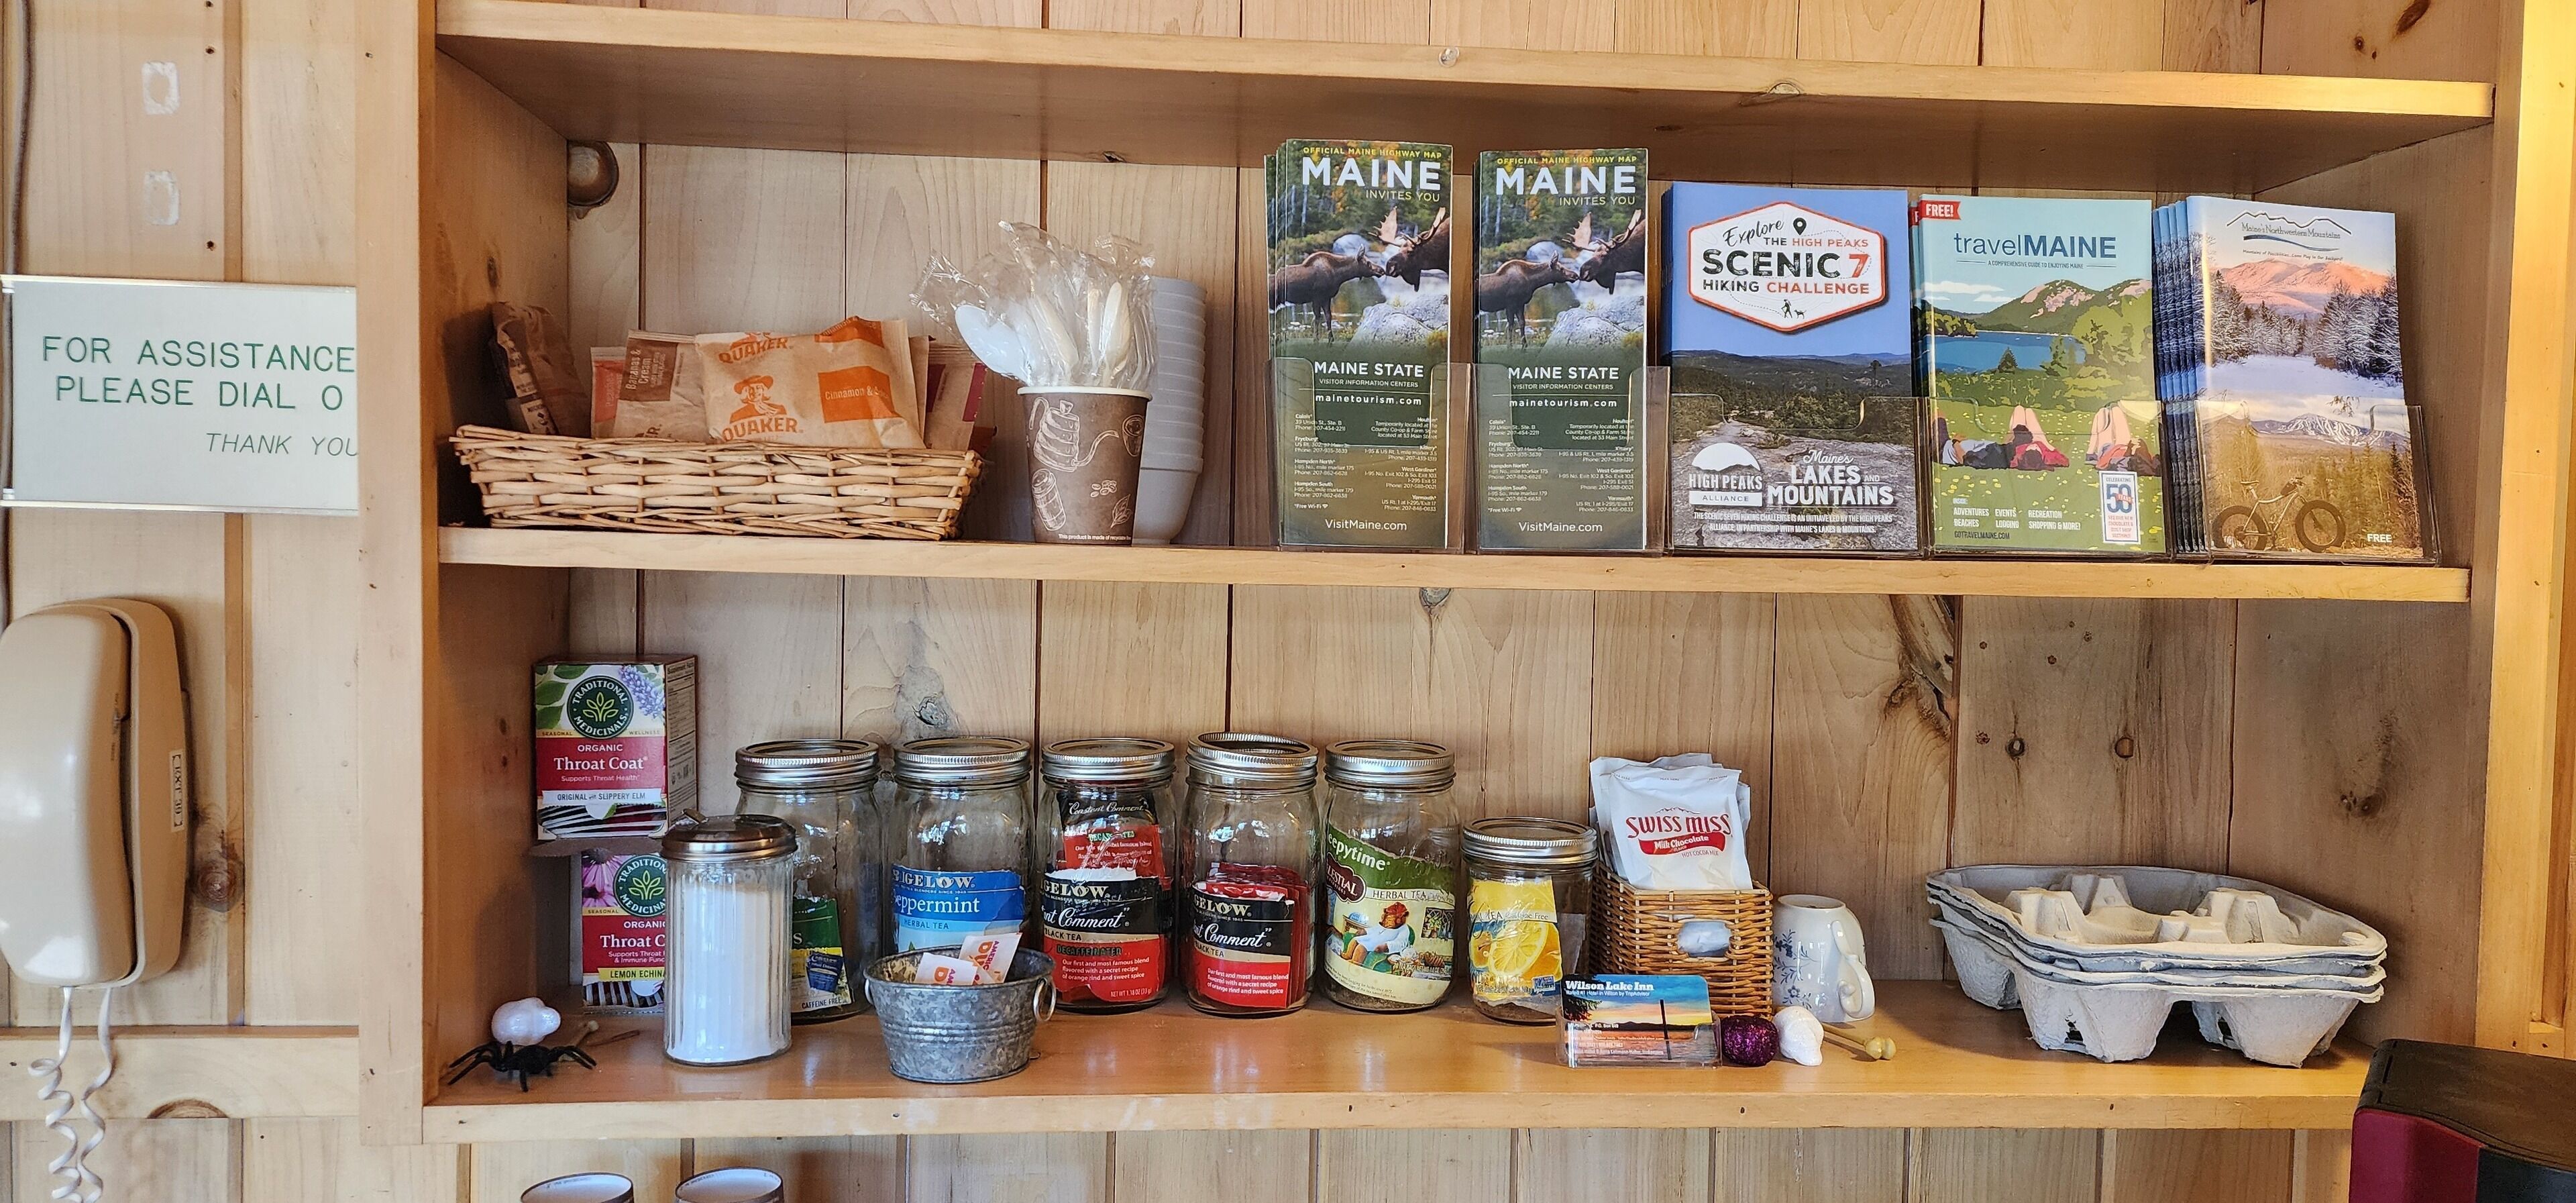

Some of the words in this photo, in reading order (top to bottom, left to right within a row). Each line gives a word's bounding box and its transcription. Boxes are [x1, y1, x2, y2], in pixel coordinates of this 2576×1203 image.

[1303, 146, 1344, 155] OFFICIAL
[1348, 148, 1376, 156] MAINE
[1380, 149, 1420, 158] HIGHWAY
[1424, 151, 1442, 159] MAP
[1302, 157, 1441, 191] MAINE
[1496, 166, 1635, 195] MAINE
[1366, 190, 1411, 201] INVITES
[1416, 192, 1440, 202] YOU
[1560, 197, 1606, 205] INVITES
[1611, 196, 1635, 205] YOU
[1925, 203, 1953, 217] FREE!
[1723, 219, 1784, 247] Explore
[2242, 222, 2265, 233] Maine's
[2265, 225, 2307, 236] Northwestern
[2308, 228, 2341, 239] Mountains
[1764, 237, 1787, 246] THE
[1792, 238, 1822, 247] HIGH
[1828, 239, 1868, 248] PEAKS
[1953, 232, 2116, 258] travelMAINE
[1703, 248, 1840, 278] SCENIC
[1849, 254, 1868, 278] 7
[1703, 279, 1759, 293] HIKING
[1767, 282, 1869, 295] CHALLENGE
[42, 336, 111, 363] FOR
[138, 339, 355, 372] ASSISTANCE
[718, 337, 788, 364] QUAKER
[625, 356, 641, 390] Bananas
[638, 358, 653, 384] Cream
[1315, 361, 1368, 375] MAINE
[1375, 364, 1424, 378] STATE
[1508, 367, 1562, 379] MAINE
[1568, 367, 1619, 380] STATE
[1345, 379, 1389, 387] INFORMATION
[56, 376, 193, 405] PLEASE
[219, 380, 295, 409] DIAL
[825, 387, 863, 401] Cinnamon
[1316, 395, 1422, 406] mainetourism.com
[1509, 399, 1617, 407] mainetourism.com
[722, 417, 798, 442] QUAKER
[207, 432, 291, 455] THANK
[311, 436, 358, 457] YOU
[1803, 449, 1854, 464] Maine's
[1688, 473, 1721, 488] HIGH
[1722, 475, 1762, 490] PEAKS
[1790, 466, 1861, 484] LAKES
[1767, 485, 1894, 505] MOUNTAINS
[2106, 484, 2133, 513] 50
[1953, 507, 1989, 517] ADVENTURES
[1995, 508, 2017, 517] EVENTS
[2028, 509, 2062, 519] RECREATION
[1325, 519, 1407, 531] VisitMaine.com
[1519, 522, 1603, 532] VisitMaine.com
[1953, 519, 1979, 527] BEACHES
[1996, 520, 2019, 529] LODGING
[2029, 521, 2056, 529] SHOPPING
[2063, 522, 2081, 531] MORE!
[1954, 531, 2010, 539] GOTRAVELMAINE.COM
[2367, 533, 2392, 543] FREE
[572, 680, 629, 704] TRADITIONAL
[573, 713, 629, 737] MEDICINALS
[577, 744, 623, 752] ORGANIC
[553, 757, 605, 771] Throat
[1626, 815, 1682, 839] SWISS
[1654, 840, 1670, 849] Milk
[1670, 835, 1709, 848] Chocolate
[1328, 833, 1385, 870] eepytime
[619, 859, 666, 882] TRADITION
[1327, 866, 1357, 896] LESTIAL
[1044, 880, 1108, 897] GELOW
[1373, 890, 1407, 899] HERBAL
[1411, 891, 1426, 899] TEA
[1194, 894, 1250, 917] GELOW
[932, 921, 949, 929] TEA
[600, 935, 650, 947] Throat
[1044, 929, 1064, 939] BLACK
[1057, 945, 1122, 956] DECAFFEINATED
[1212, 949, 1224, 957] TEA
[610, 970, 637, 978] LEMON
[1566, 981, 1605, 990] Wilson
[1605, 982, 1633, 990] Lake
[1634, 982, 1654, 991] Inn
[802, 998, 827, 1009] CAFFEINE
[828, 997, 842, 1005] FREE
